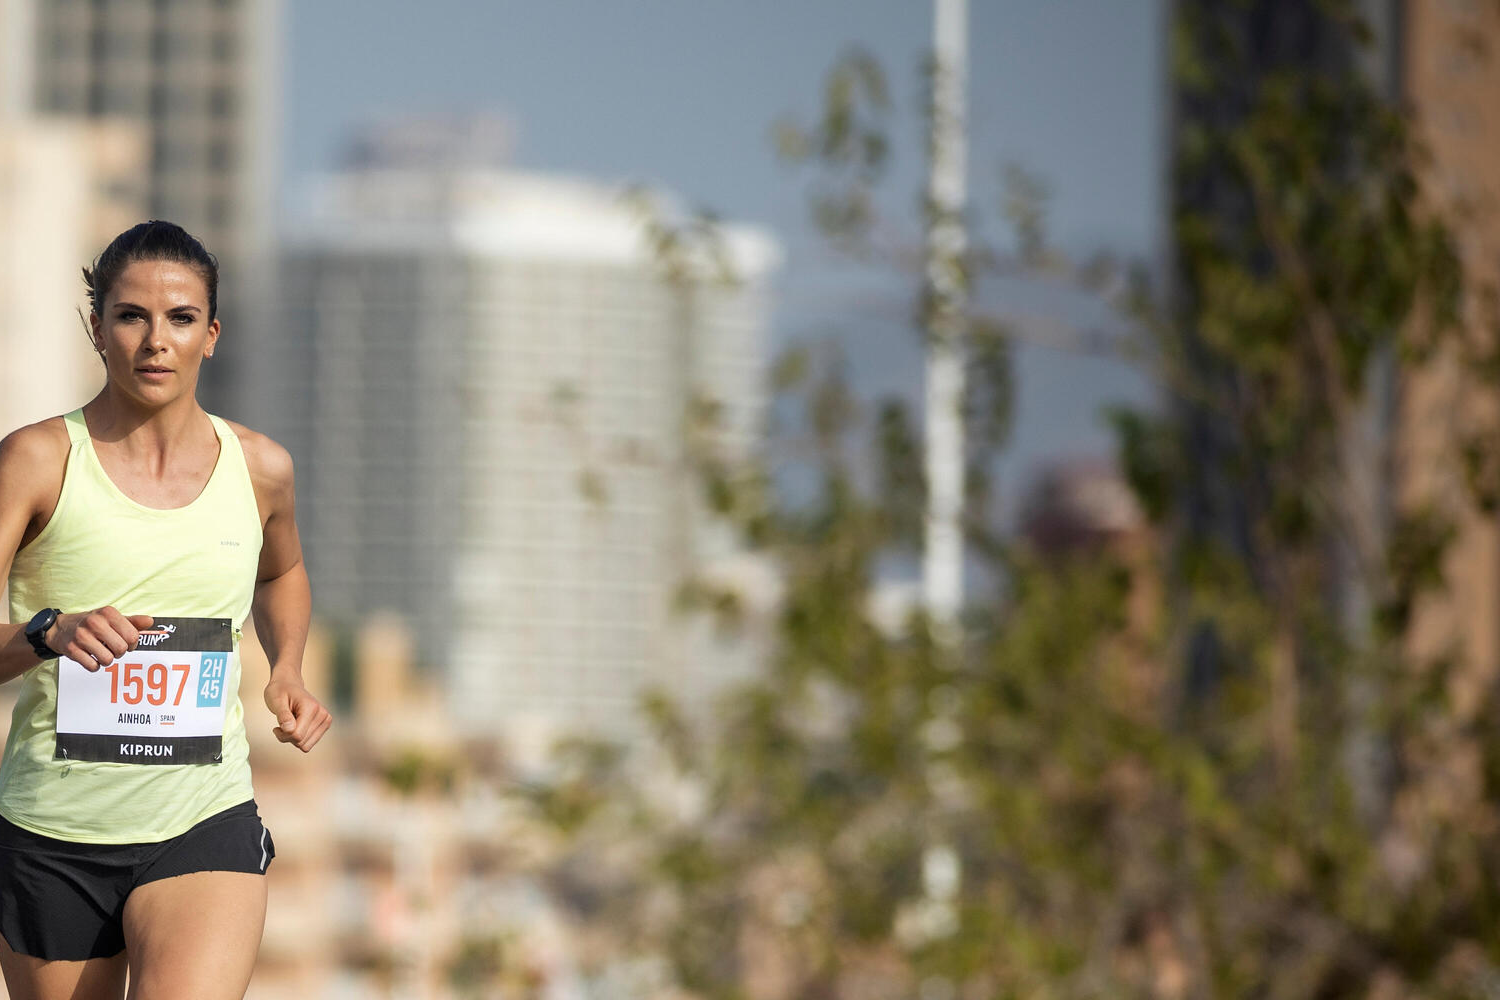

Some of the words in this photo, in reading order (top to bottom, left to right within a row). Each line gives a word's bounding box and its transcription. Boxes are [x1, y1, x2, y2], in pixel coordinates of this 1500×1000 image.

[202, 658, 223, 678] 2H
[105, 663, 191, 706] 1597
[200, 680, 220, 699] 45
[117, 712, 151, 725] AINHOA
[160, 714, 176, 722] SPAIN
[120, 743, 173, 757] KIPRUN
